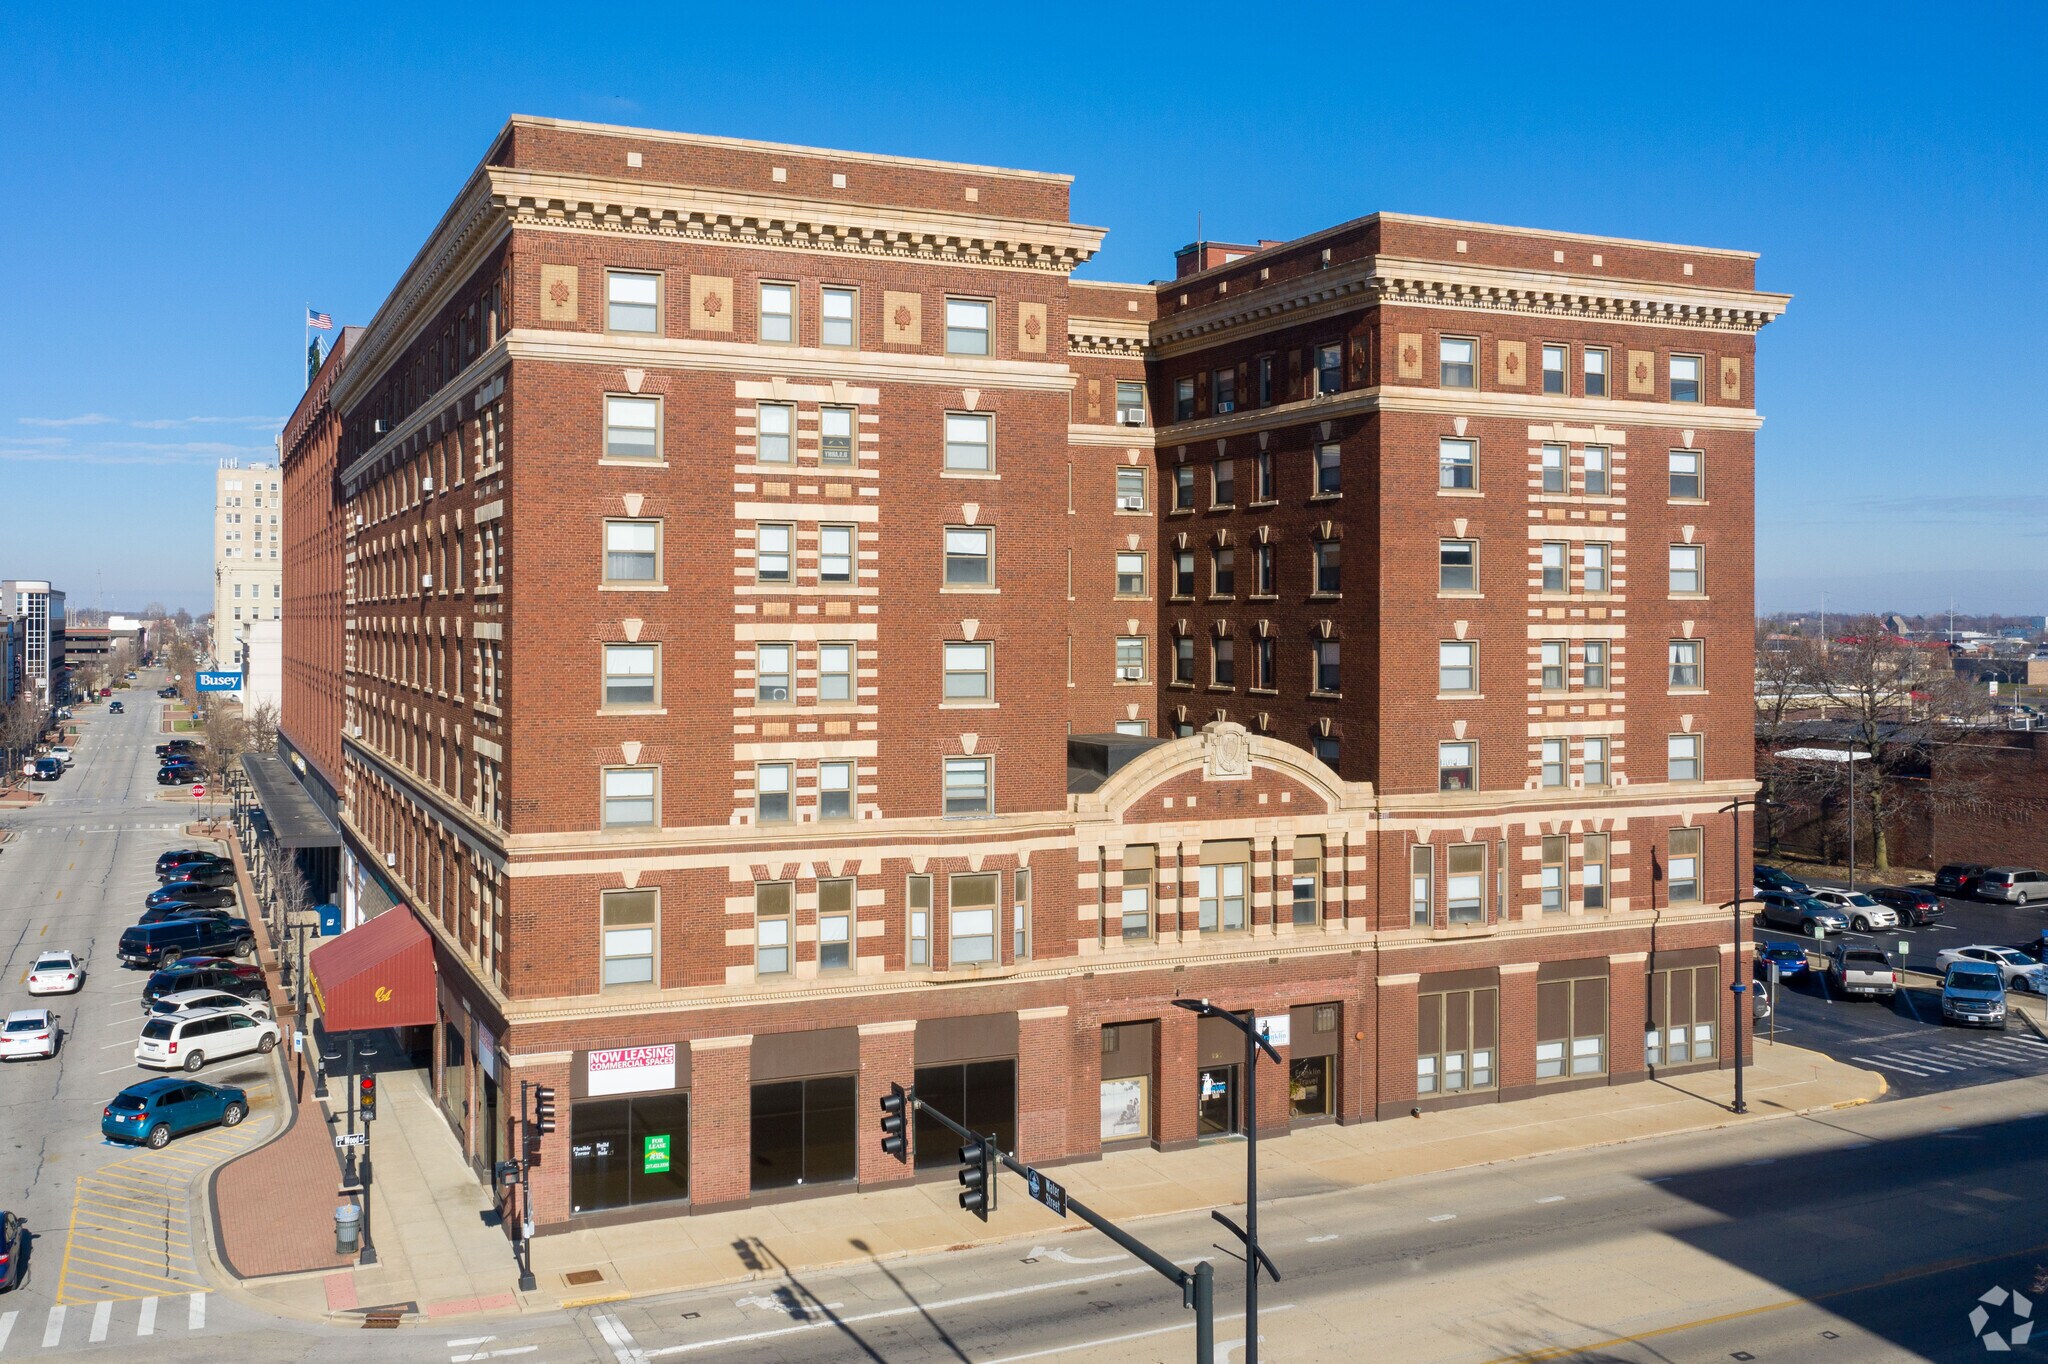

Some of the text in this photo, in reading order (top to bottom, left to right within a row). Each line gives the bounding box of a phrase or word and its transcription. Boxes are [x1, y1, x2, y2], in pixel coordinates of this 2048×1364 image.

[200, 674, 239, 688] Busey
[192, 787, 205, 795] STOP
[590, 1047, 674, 1064] NOW LEASING
[590, 1056, 673, 1071] COMMERCIAL SPACES
[345, 1135, 360, 1145] Wood
[1046, 1179, 1060, 1198] Water
[1046, 1193, 1061, 1212] Street
